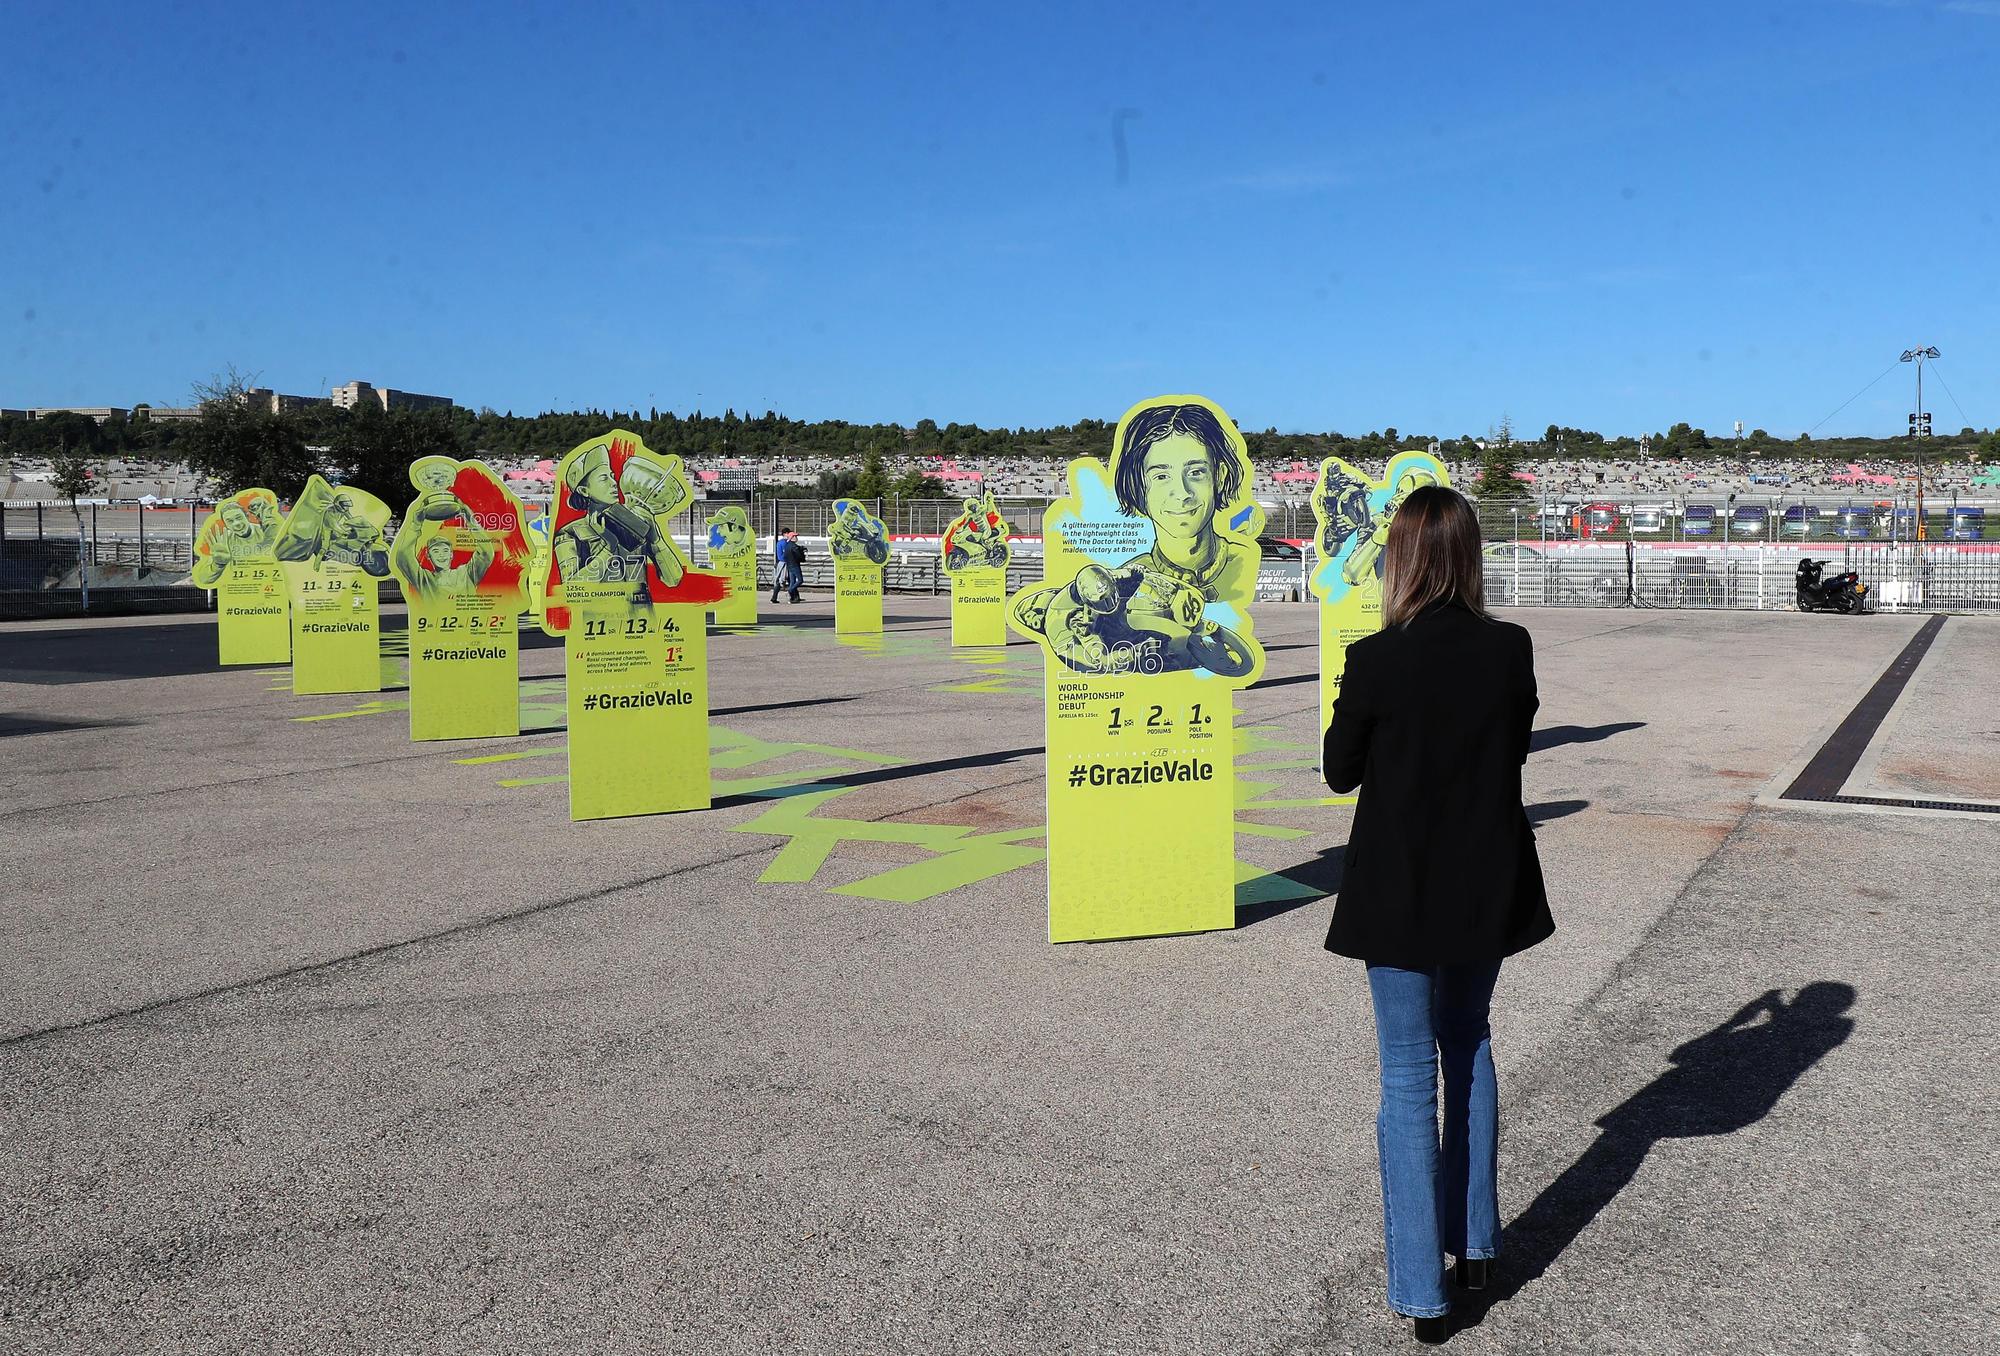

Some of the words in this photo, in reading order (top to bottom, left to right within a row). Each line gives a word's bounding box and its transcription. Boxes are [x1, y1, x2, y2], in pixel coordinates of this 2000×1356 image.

[454, 512, 516, 532] 1999
[325, 550, 374, 565] 2001
[566, 555, 646, 582] 1997
[303, 581, 316, 590] 11
[328, 581, 341, 589] 13
[352, 580, 358, 589] 4
[226, 606, 282, 615] #GrazieVale
[302, 622, 369, 632] #GrazieVale
[418, 618, 427, 628] 9
[440, 617, 458, 628] 12
[470, 616, 479, 627] 5
[585, 620, 606, 636] 11
[625, 619, 647, 634] 13
[663, 618, 674, 632] 4
[422, 647, 506, 660] #GrazieVale
[1057, 640, 1163, 679] 1996
[584, 689, 692, 710] #GrazieVale
[1058, 692, 1125, 700] CHAMPIONSHIP
[1108, 708, 1122, 728] 1
[1147, 705, 1162, 726] 2
[1189, 704, 1201, 724] 1
[1068, 758, 1213, 787] #GrazieVale
